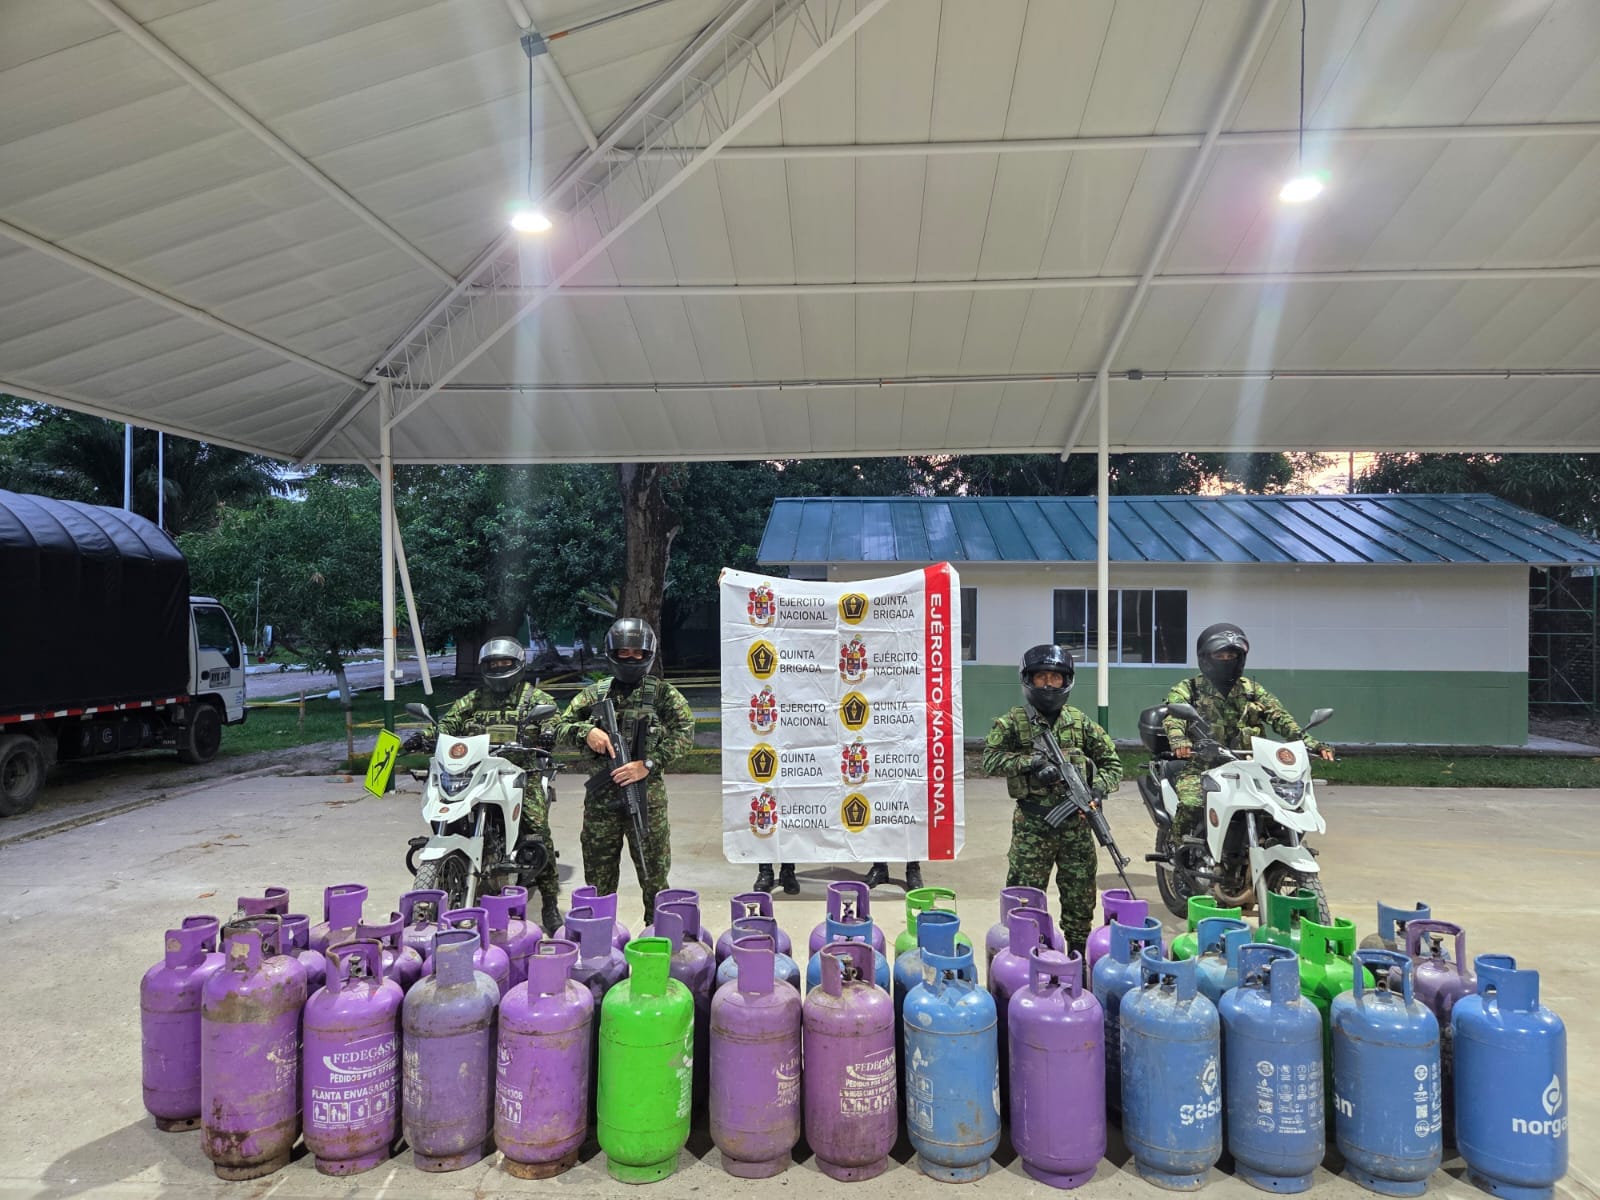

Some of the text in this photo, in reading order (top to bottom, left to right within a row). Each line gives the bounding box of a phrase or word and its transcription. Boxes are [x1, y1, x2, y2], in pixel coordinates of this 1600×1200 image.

[873, 595, 908, 606] QUINTA
[780, 610, 828, 621] NACIONAL
[873, 609, 915, 619] BRIGADA
[779, 650, 815, 661] QUINTA
[779, 664, 822, 674] BRIGADA
[873, 666, 921, 676] NACIONAL
[873, 701, 908, 712] QUINTA
[930, 594, 945, 829] EJÉRCITO NACIONAL
[780, 716, 829, 727] NACIONAL
[873, 714, 915, 725] BRIGADA
[780, 753, 816, 763] QUINTA
[780, 767, 823, 777] BRIGADA
[874, 767, 922, 778] NACIONAL
[874, 801, 910, 812] QUINTA
[781, 818, 830, 829] NACIONAL
[874, 815, 917, 825] BRIGADA
[330, 1073, 361, 1084] PEDIDOS
[312, 1089, 341, 1101] PLANTA
[344, 1079, 390, 1100] ENVASADO
